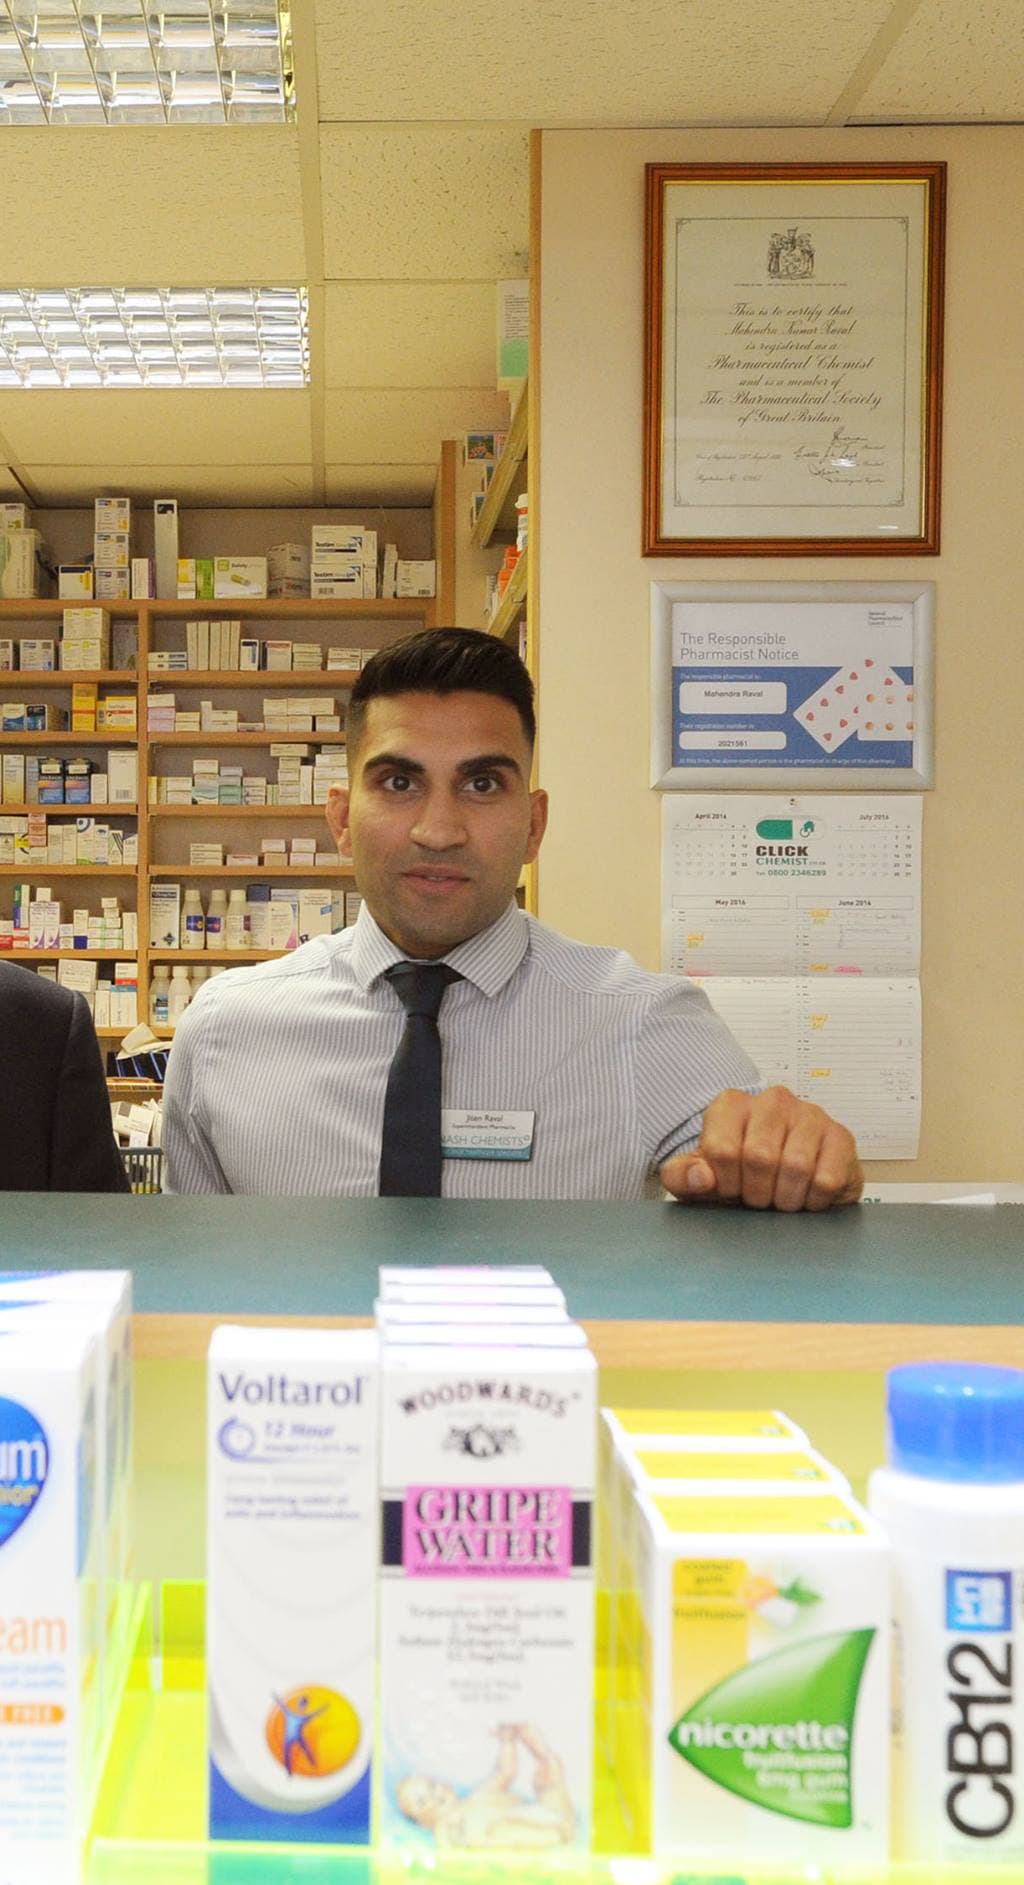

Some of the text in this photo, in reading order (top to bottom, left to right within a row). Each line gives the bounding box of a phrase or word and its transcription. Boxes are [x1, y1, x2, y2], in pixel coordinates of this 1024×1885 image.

[729, 303, 754, 315] This
[826, 304, 853, 315] that
[708, 354, 876, 369] Pharmaceutical Chemist
[787, 375, 828, 386] member
[728, 391, 831, 405] Pharmaceutical
[680, 632, 786, 649] The Responsible
[680, 648, 799, 661] Pharmacist Notice
[704, 690, 764, 698] Mahendra Raval
[756, 846, 808, 856] CLICK
[716, 899, 729, 907] May
[485, 1114, 504, 1122] Raval
[471, 1136, 524, 1146] CHEMISTS
[217, 1373, 364, 1406] Voltarol
[416, 1488, 561, 1526] GRIPE
[416, 1529, 559, 1564] WATER
[677, 1717, 849, 1750] nicorette
[946, 1641, 1014, 1839] CB12
